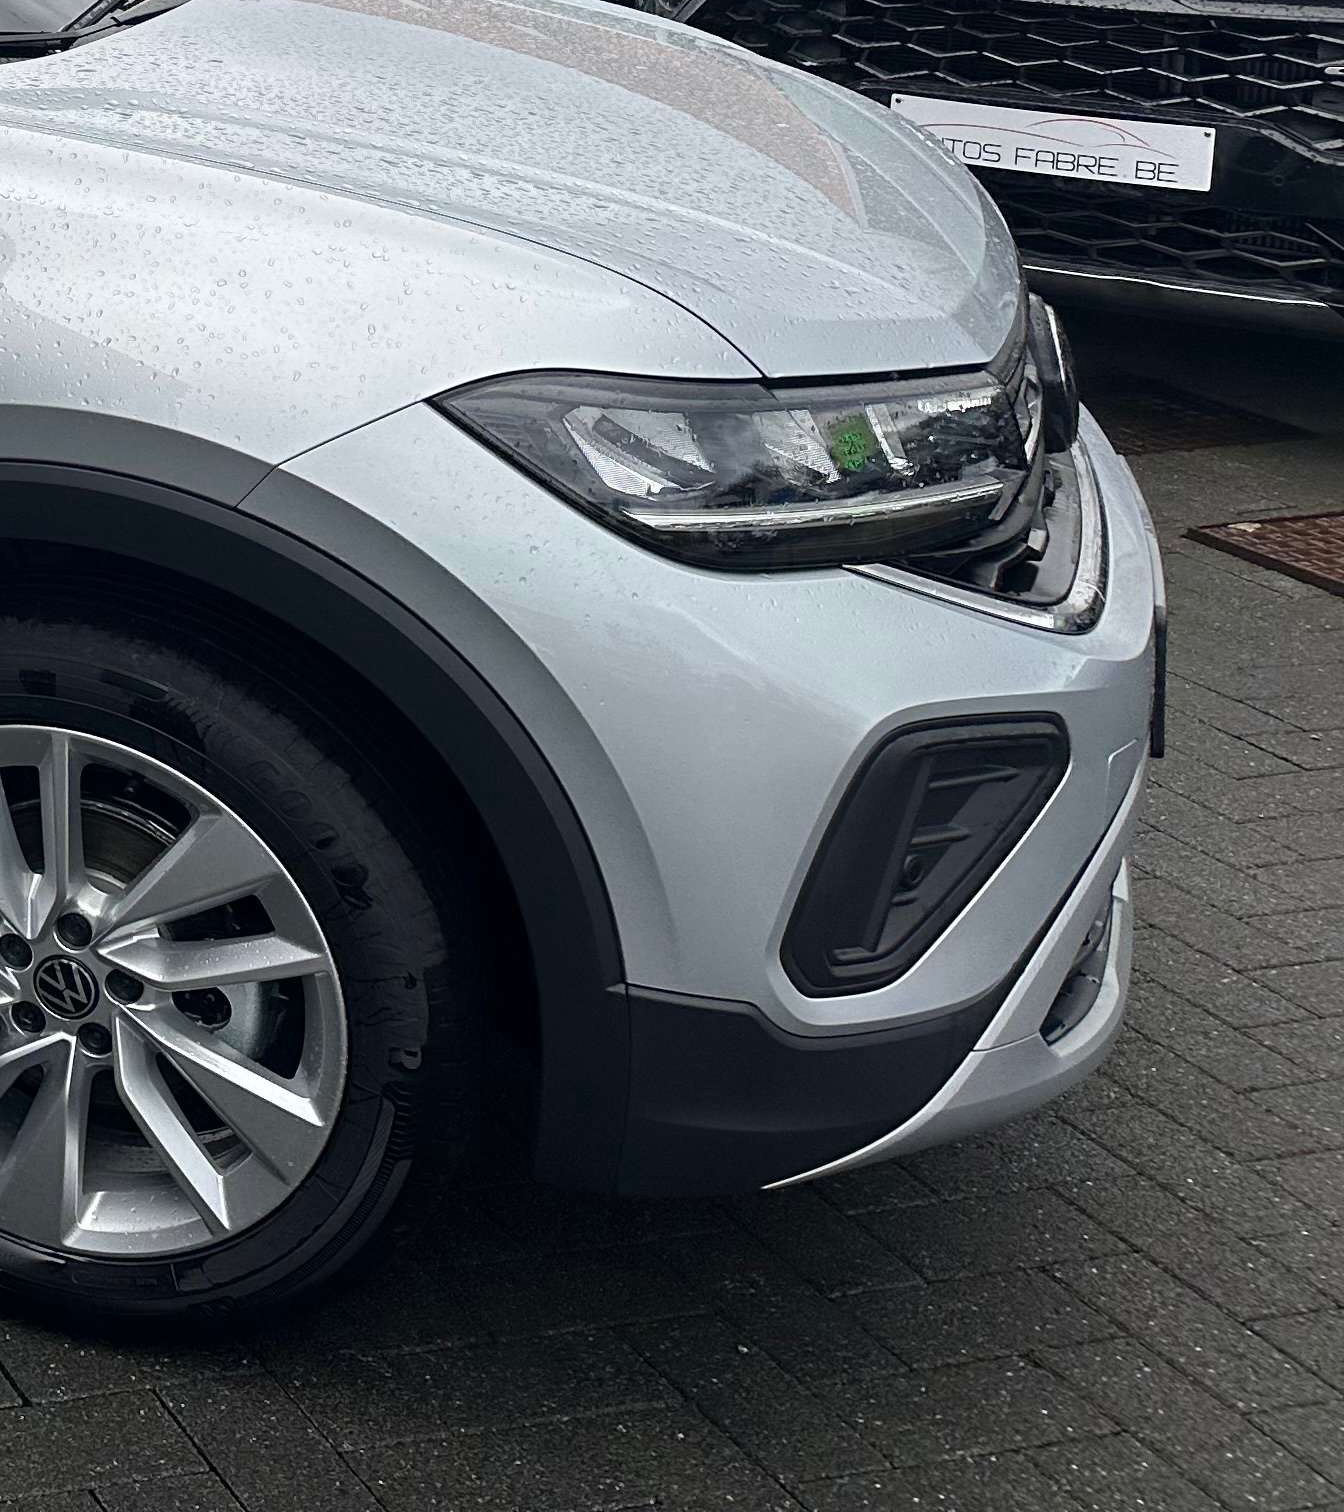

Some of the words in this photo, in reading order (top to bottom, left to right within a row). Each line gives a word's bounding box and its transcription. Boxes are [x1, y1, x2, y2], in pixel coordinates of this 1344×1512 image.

[941, 137, 1002, 163] TOS
[1014, 147, 1120, 177] FABRE
[1135, 160, 1180, 184] BE
